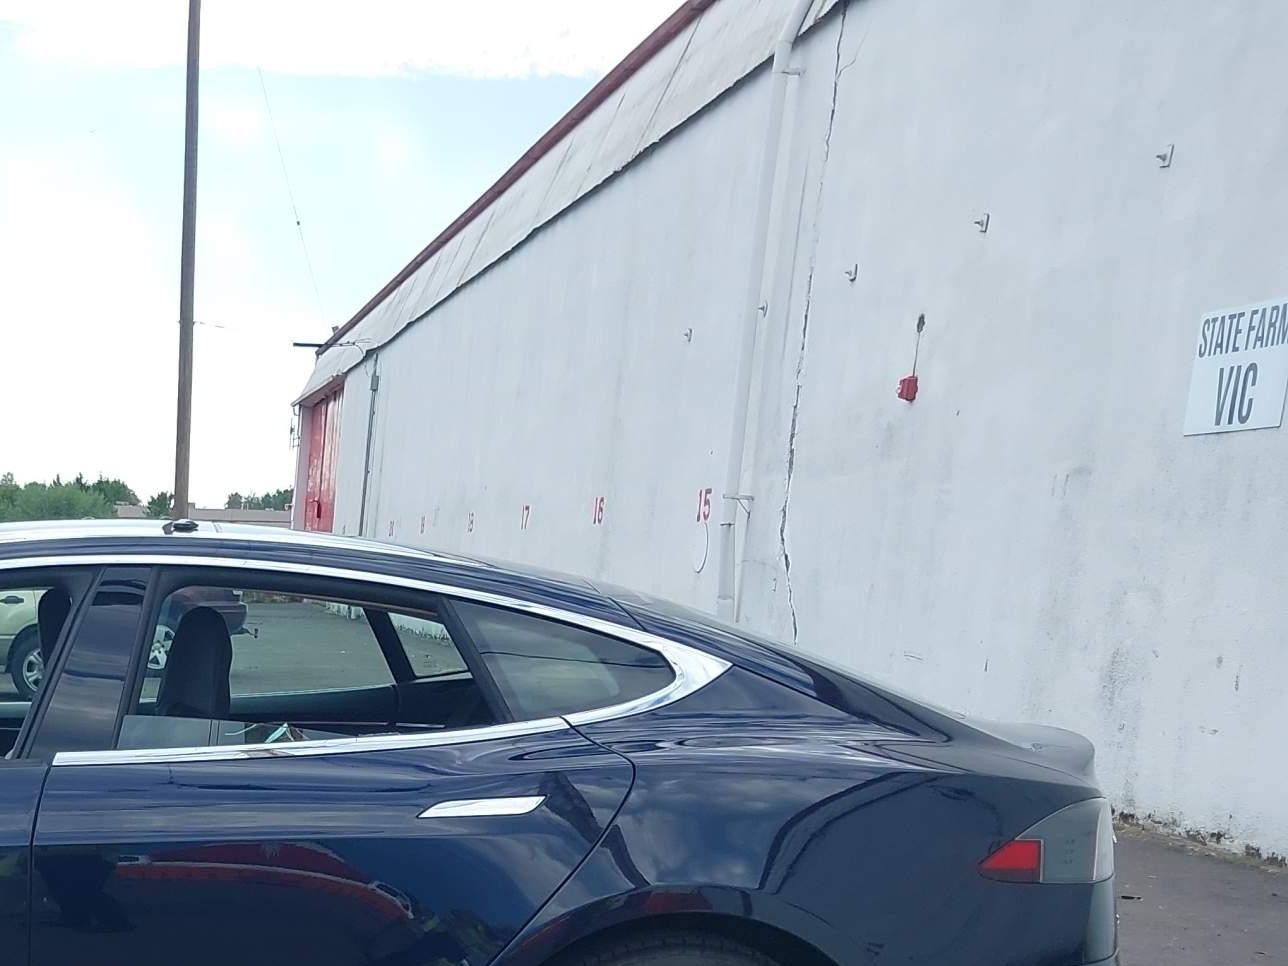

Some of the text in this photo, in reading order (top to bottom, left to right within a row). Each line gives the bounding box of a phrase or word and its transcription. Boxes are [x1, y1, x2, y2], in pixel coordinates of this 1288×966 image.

[1198, 311, 1246, 358] STATE
[1214, 362, 1259, 427] VIC
[520, 505, 531, 530] 17
[593, 497, 605, 525] 16
[697, 488, 712, 522] 15
